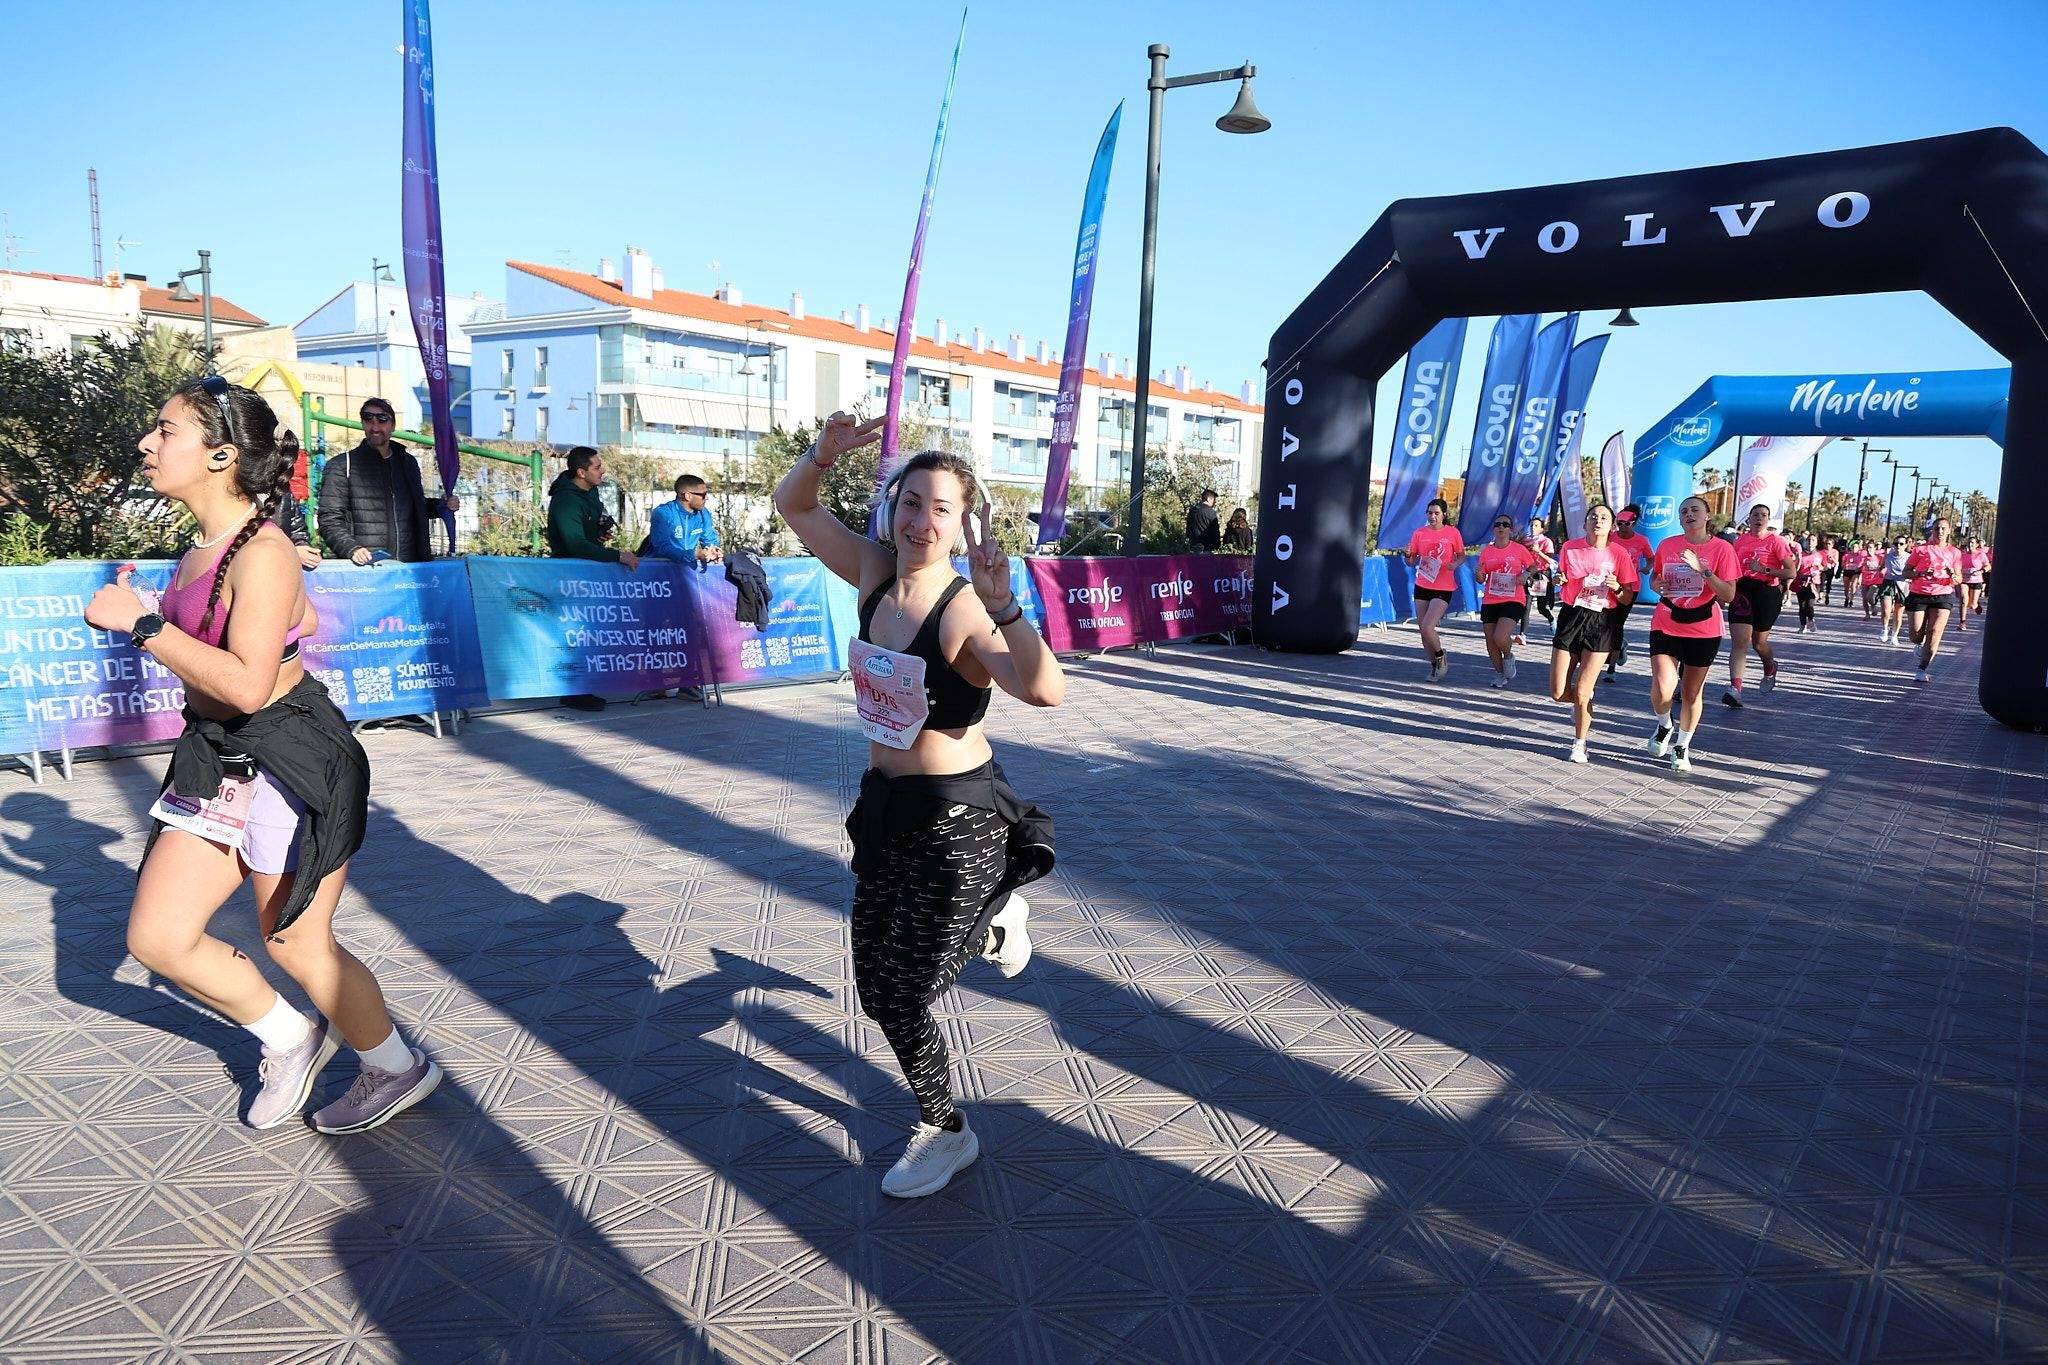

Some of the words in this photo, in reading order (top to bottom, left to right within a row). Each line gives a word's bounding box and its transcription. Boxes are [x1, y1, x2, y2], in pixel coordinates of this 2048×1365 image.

[1453, 191, 1871, 259] VOLVO
[1404, 361, 1444, 457] GOYA
[1789, 379, 1920, 428] Marlene
[1481, 383, 1516, 468] GOYA
[1515, 397, 1549, 475] GOYA
[1271, 378, 1303, 615] VOLVO
[560, 580, 672, 598] VISIBILICEMOS
[1068, 577, 1123, 612] renfe
[1151, 571, 1194, 605] renfe
[1213, 569, 1254, 600] renfe
[559, 605, 618, 622] JUNTOS
[620, 606, 640, 622] EL
[1078, 618, 1096, 629] TREN
[1097, 616, 1125, 628] OFICIAL
[1160, 611, 1175, 621] TREN
[1175, 608, 1195, 620] OFICIAL
[0, 627, 86, 654] UNTOS
[565, 625, 627, 647] CÁNCER
[627, 630, 647, 646] DE
[648, 628, 687, 646] MAMA
[103, 657, 136, 681] DE
[396, 660, 441, 678] SÚMATE
[585, 649, 687, 672] METASTÁSICO
[397, 677, 456, 691] MOVIMIENTO
[25, 684, 187, 723] METASTÁSIC
[217, 784, 236, 802] 16
